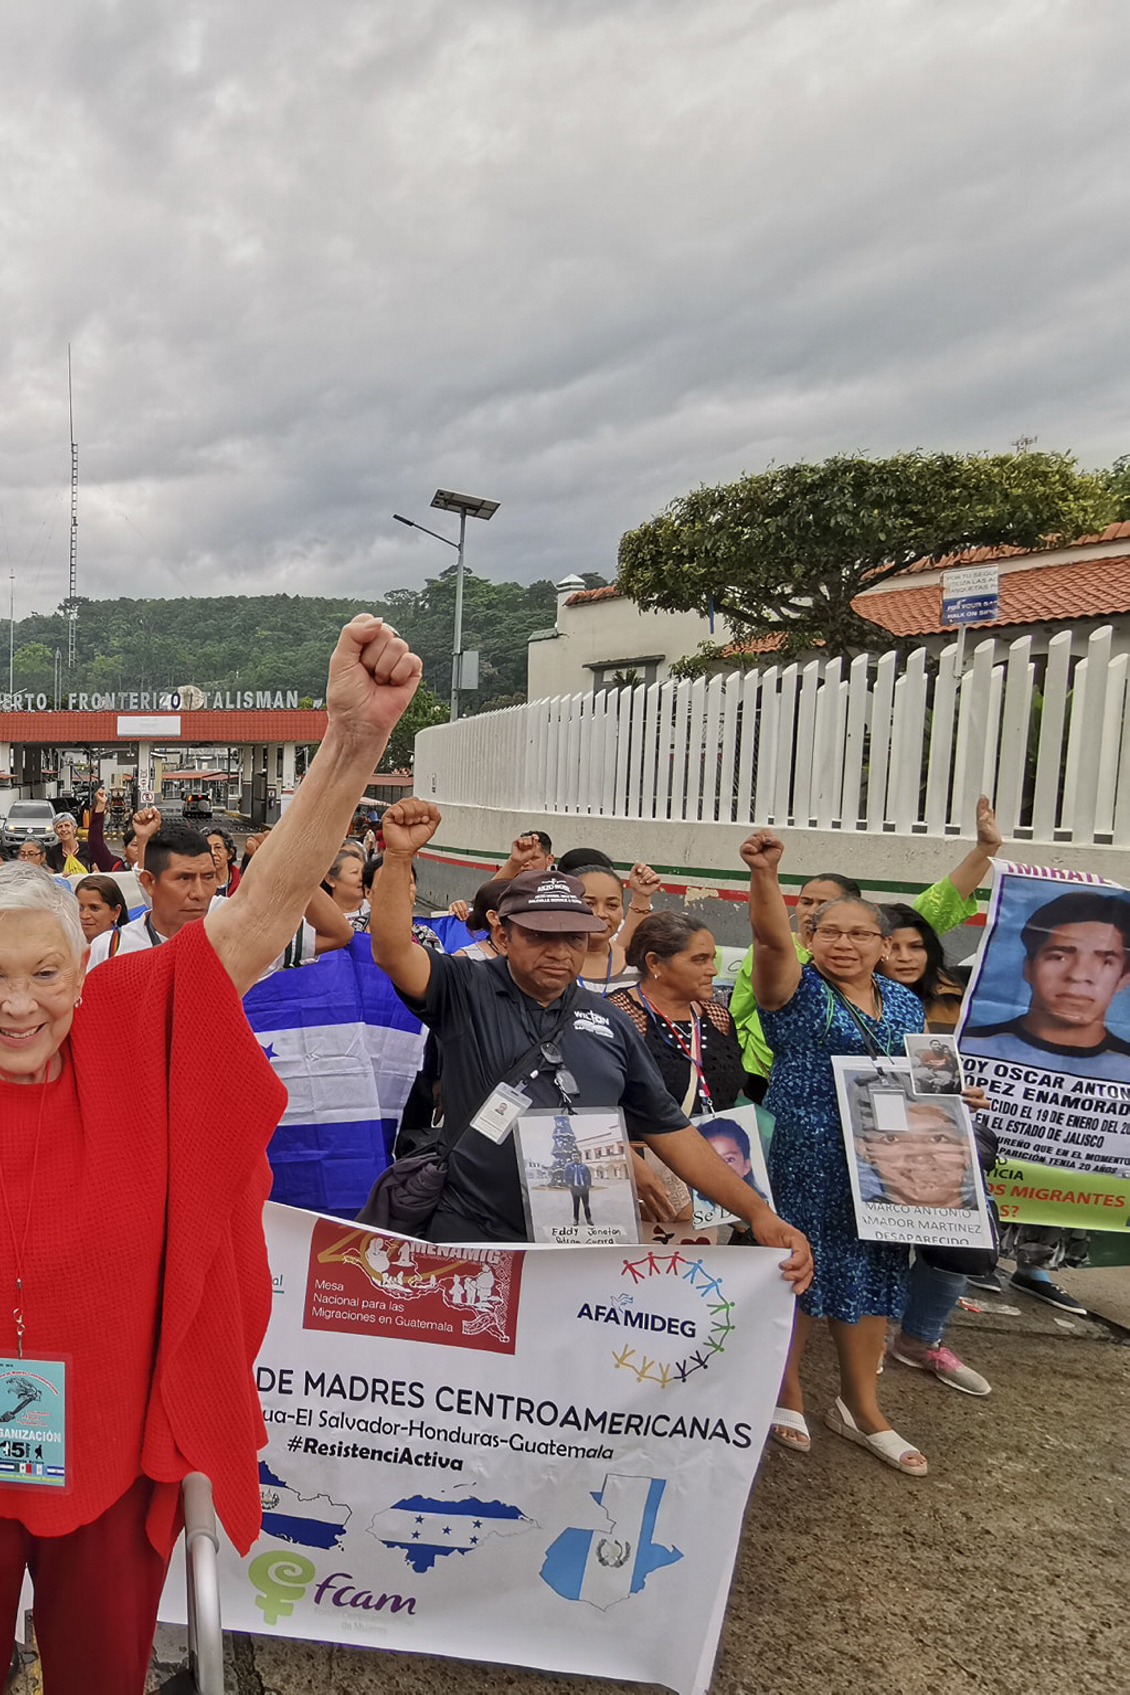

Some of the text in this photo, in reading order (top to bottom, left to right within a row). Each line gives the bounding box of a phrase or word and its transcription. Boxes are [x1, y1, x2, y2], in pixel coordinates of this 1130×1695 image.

[203, 690, 299, 710] TALISMAN
[994, 1064, 1065, 1089] OSCAR
[975, 1112, 1105, 1149] EN EL ESTADO DE JALISCO
[1020, 1105, 1032, 1119] EL
[1066, 1115, 1099, 1132] ENERO
[1101, 1119, 1119, 1134] DEL
[1033, 1143, 1054, 1154] QUE
[1056, 1147, 1069, 1157] EN
[1071, 1151, 1083, 1160] EL
[1079, 1163, 1091, 1171] 20
[867, 1202, 911, 1214] MARCO
[1010, 1185, 1126, 1208] MIGRANTES
[693, 1210, 713, 1225] Se
[917, 1221, 982, 1234] MARTINEZ
[551, 1226, 579, 1237] Eddy
[410, 1241, 502, 1265] MENAMIG
[314, 1279, 344, 1292] Mesa
[313, 1293, 405, 1312] Nacional para las
[311, 1307, 454, 1333] Migraciones en Guatemala
[256, 1367, 753, 1450] DE MADRES CENTROAMERICANAS
[318, 1410, 614, 1461] Salvador-Honduras-Guatemala
[287, 1435, 464, 1472] #ResistenciActiva
[313, 1572, 417, 1616] fcam
